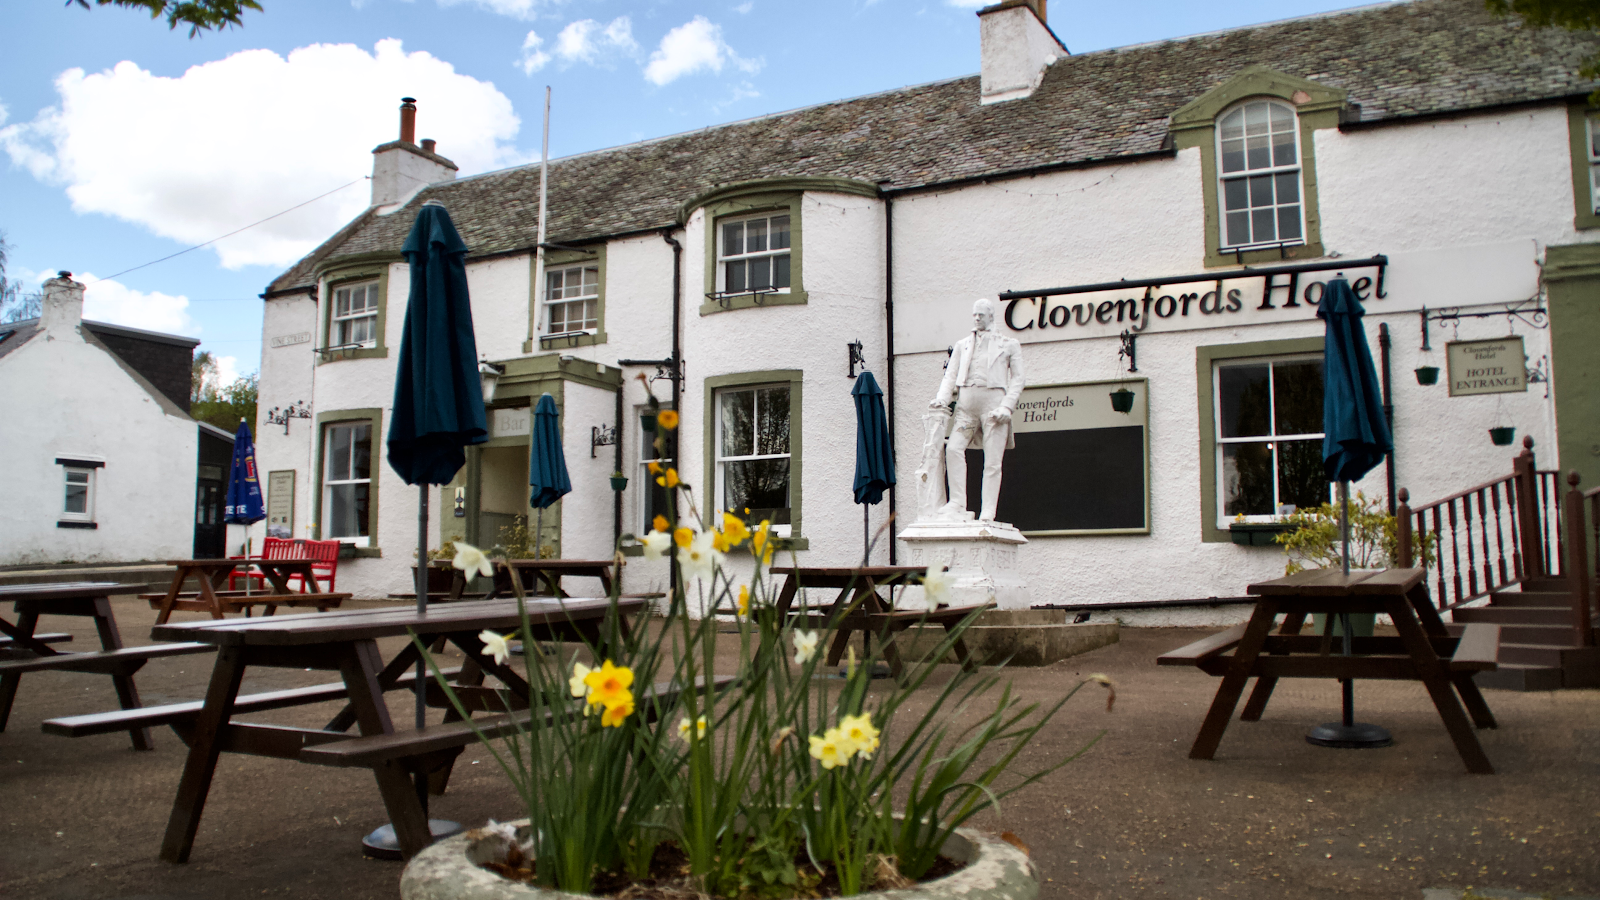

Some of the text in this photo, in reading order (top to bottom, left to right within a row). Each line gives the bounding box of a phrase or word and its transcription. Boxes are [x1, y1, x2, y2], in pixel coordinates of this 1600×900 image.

[1004, 264, 1389, 332] Clovenfords Hoel
[1463, 344, 1506, 354] Clovenfords
[1466, 367, 1507, 378] HOTEL
[1456, 377, 1520, 390] ENTRANCE
[1015, 396, 1074, 411] lovenfords
[1023, 410, 1057, 422] Hotel
[500, 415, 525, 431] Bar
